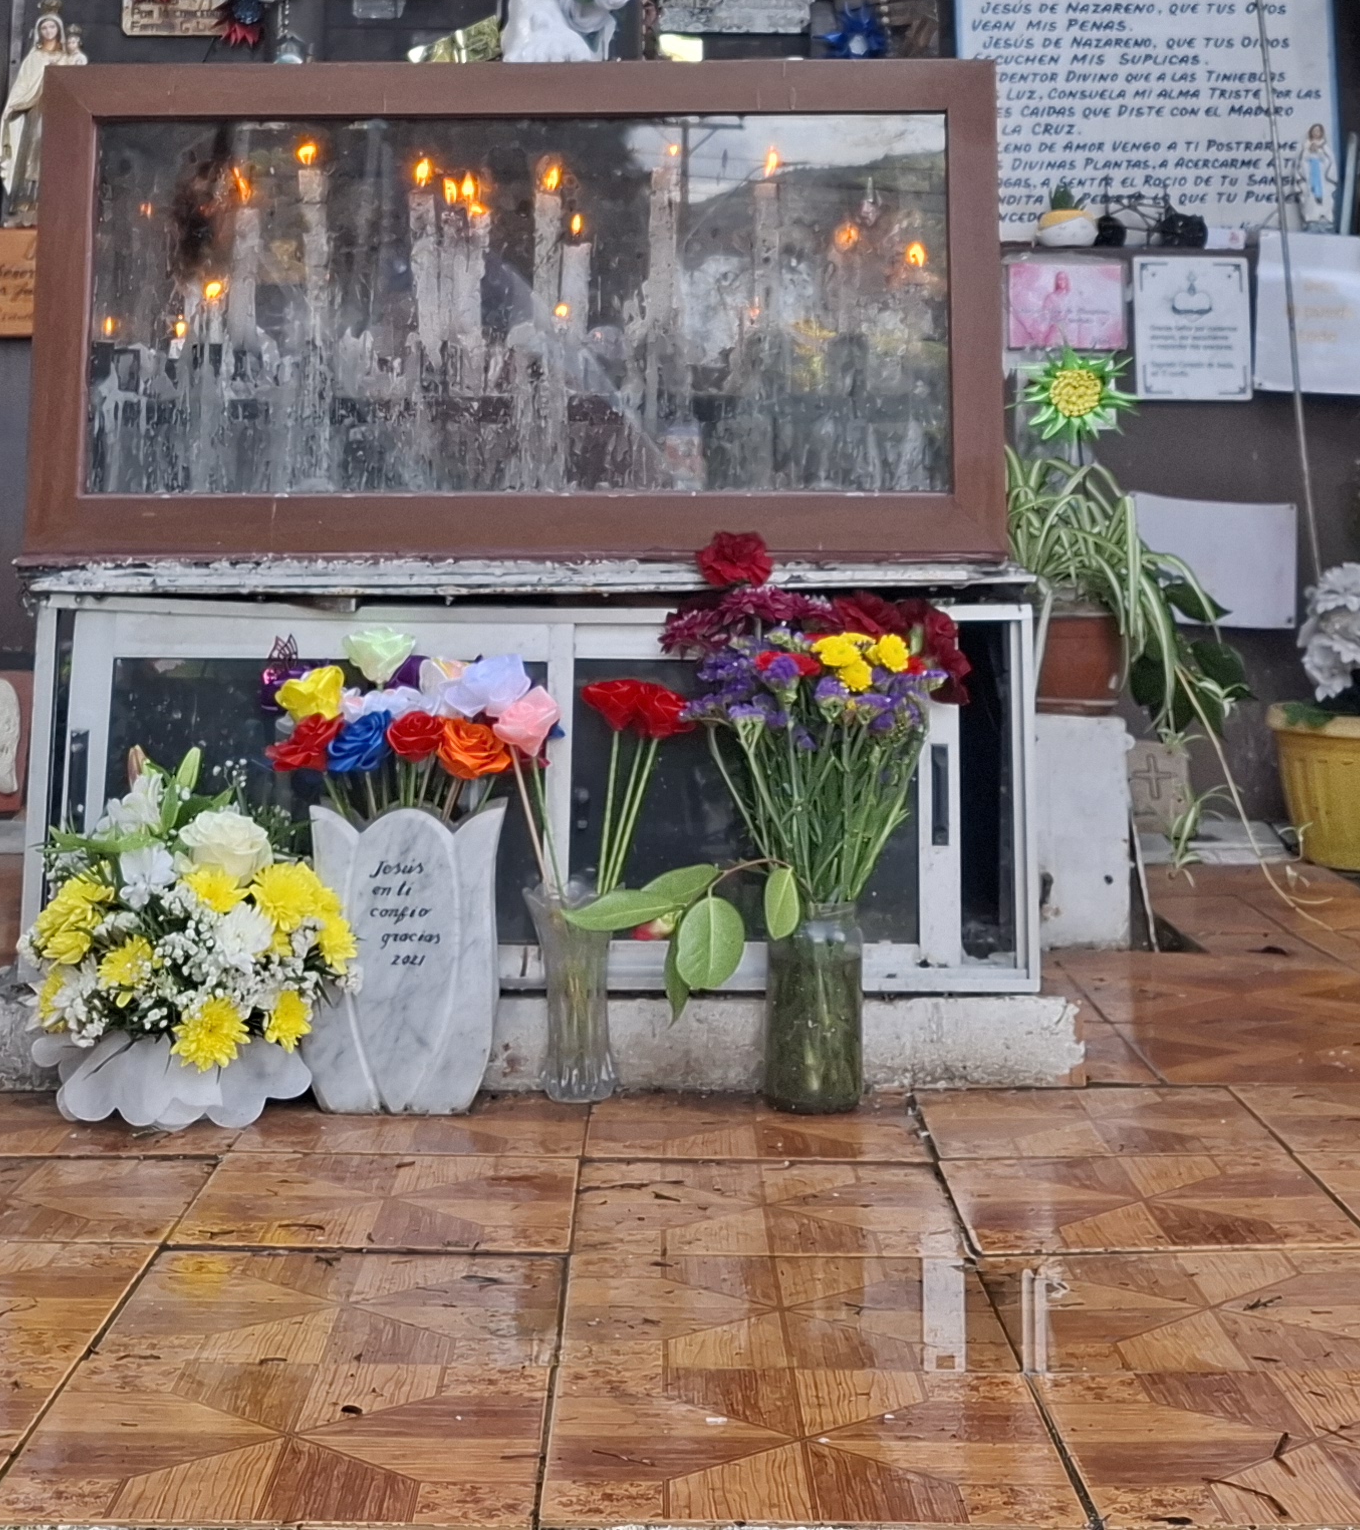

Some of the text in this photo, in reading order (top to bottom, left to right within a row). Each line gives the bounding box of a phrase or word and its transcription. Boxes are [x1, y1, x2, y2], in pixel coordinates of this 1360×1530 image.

[1037, 0, 1059, 15] DE
[1167, 0, 1200, 15] QUE
[1206, 0, 1237, 15] TUS
[970, 17, 1016, 32] VEAN
[1025, 17, 1058, 32] MIS
[372, 880, 412, 897] en ti
[370, 905, 432, 924] confio
[381, 932, 441, 949] gracias
[391, 954, 426, 967] 2021
